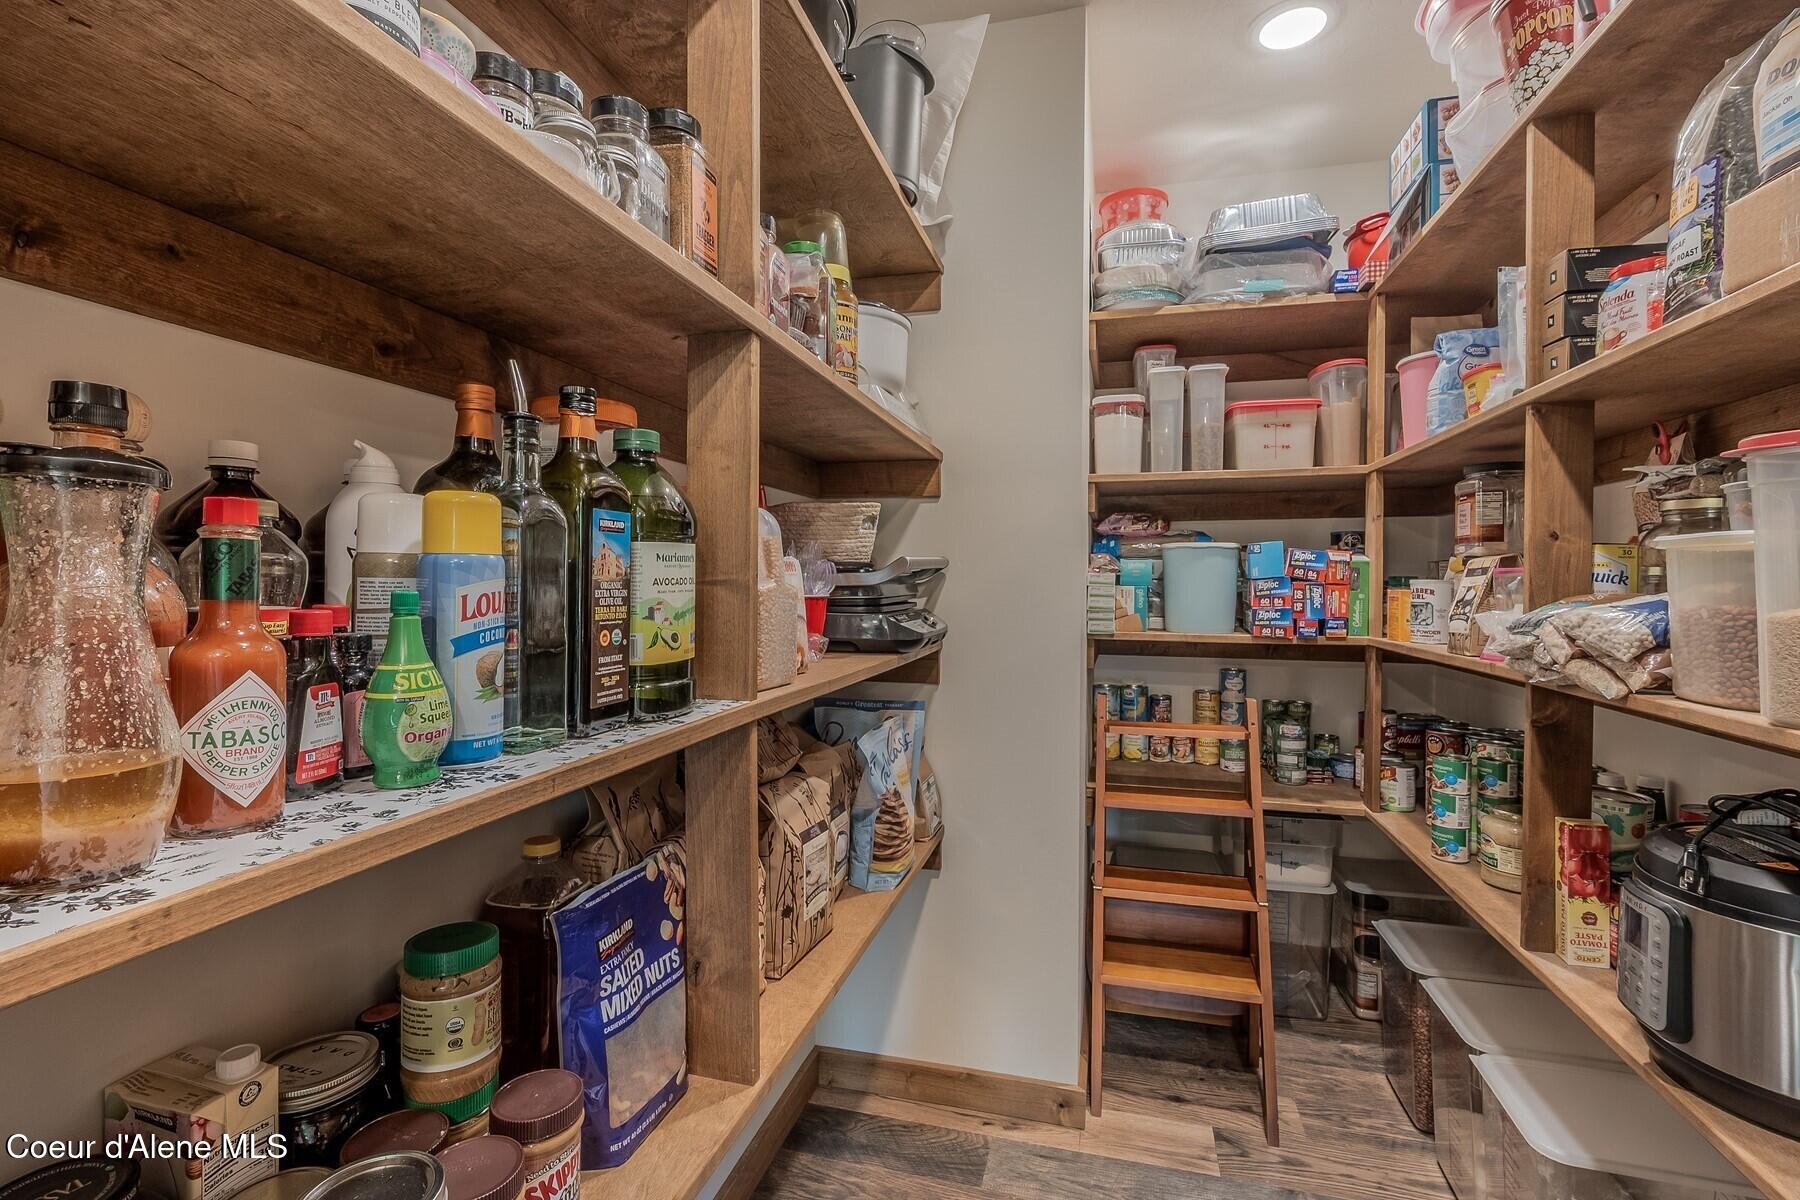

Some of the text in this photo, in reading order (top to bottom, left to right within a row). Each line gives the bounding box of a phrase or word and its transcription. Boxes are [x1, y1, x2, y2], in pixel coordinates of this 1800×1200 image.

[1671, 238, 1686, 255] ECAF
[1676, 246, 1699, 261] ROAST
[1600, 289, 1635, 311] Splenda
[599, 519, 625, 528] KIRKLAND
[1291, 551, 1317, 561] Ziploc
[1293, 568, 1303, 576] 60
[1307, 571, 1317, 579] 84
[1592, 569, 1629, 586] uick
[600, 581, 623, 590] ORGANIC
[652, 577, 688, 586] AVOCADO
[1256, 580, 1279, 591] Ziploc
[594, 589, 628, 598] EXTRA VIRGIN
[1311, 585, 1322, 609] Ziploc
[599, 597, 623, 606] OLIVE OIL
[1256, 610, 1281, 620] Ziploc
[429, 699, 449, 712] Lime
[854, 700, 884, 708] Greatest
[473, 739, 486, 748] NET
[225, 745, 265, 758] BRAND
[202, 742, 281, 777] PEPPER SAUCE
[599, 918, 634, 953] KIRKLAND
[1574, 931, 1603, 941] PASTE
[1569, 938, 1608, 949] TOMATO
[600, 952, 623, 975] EXTRA
[1576, 954, 1601, 964] CENTO
[600, 948, 645, 998] SALTED
[600, 947, 680, 1023] MIXED NUTS
[603, 1018, 626, 1034] CASHEWS
[133, 1109, 174, 1127] KIRKLAND
[610, 1142, 622, 1152] NET
[622, 1138, 632, 1147] WT
[526, 1159, 561, 1183] Need to
[204, 1168, 234, 1194] Calories
